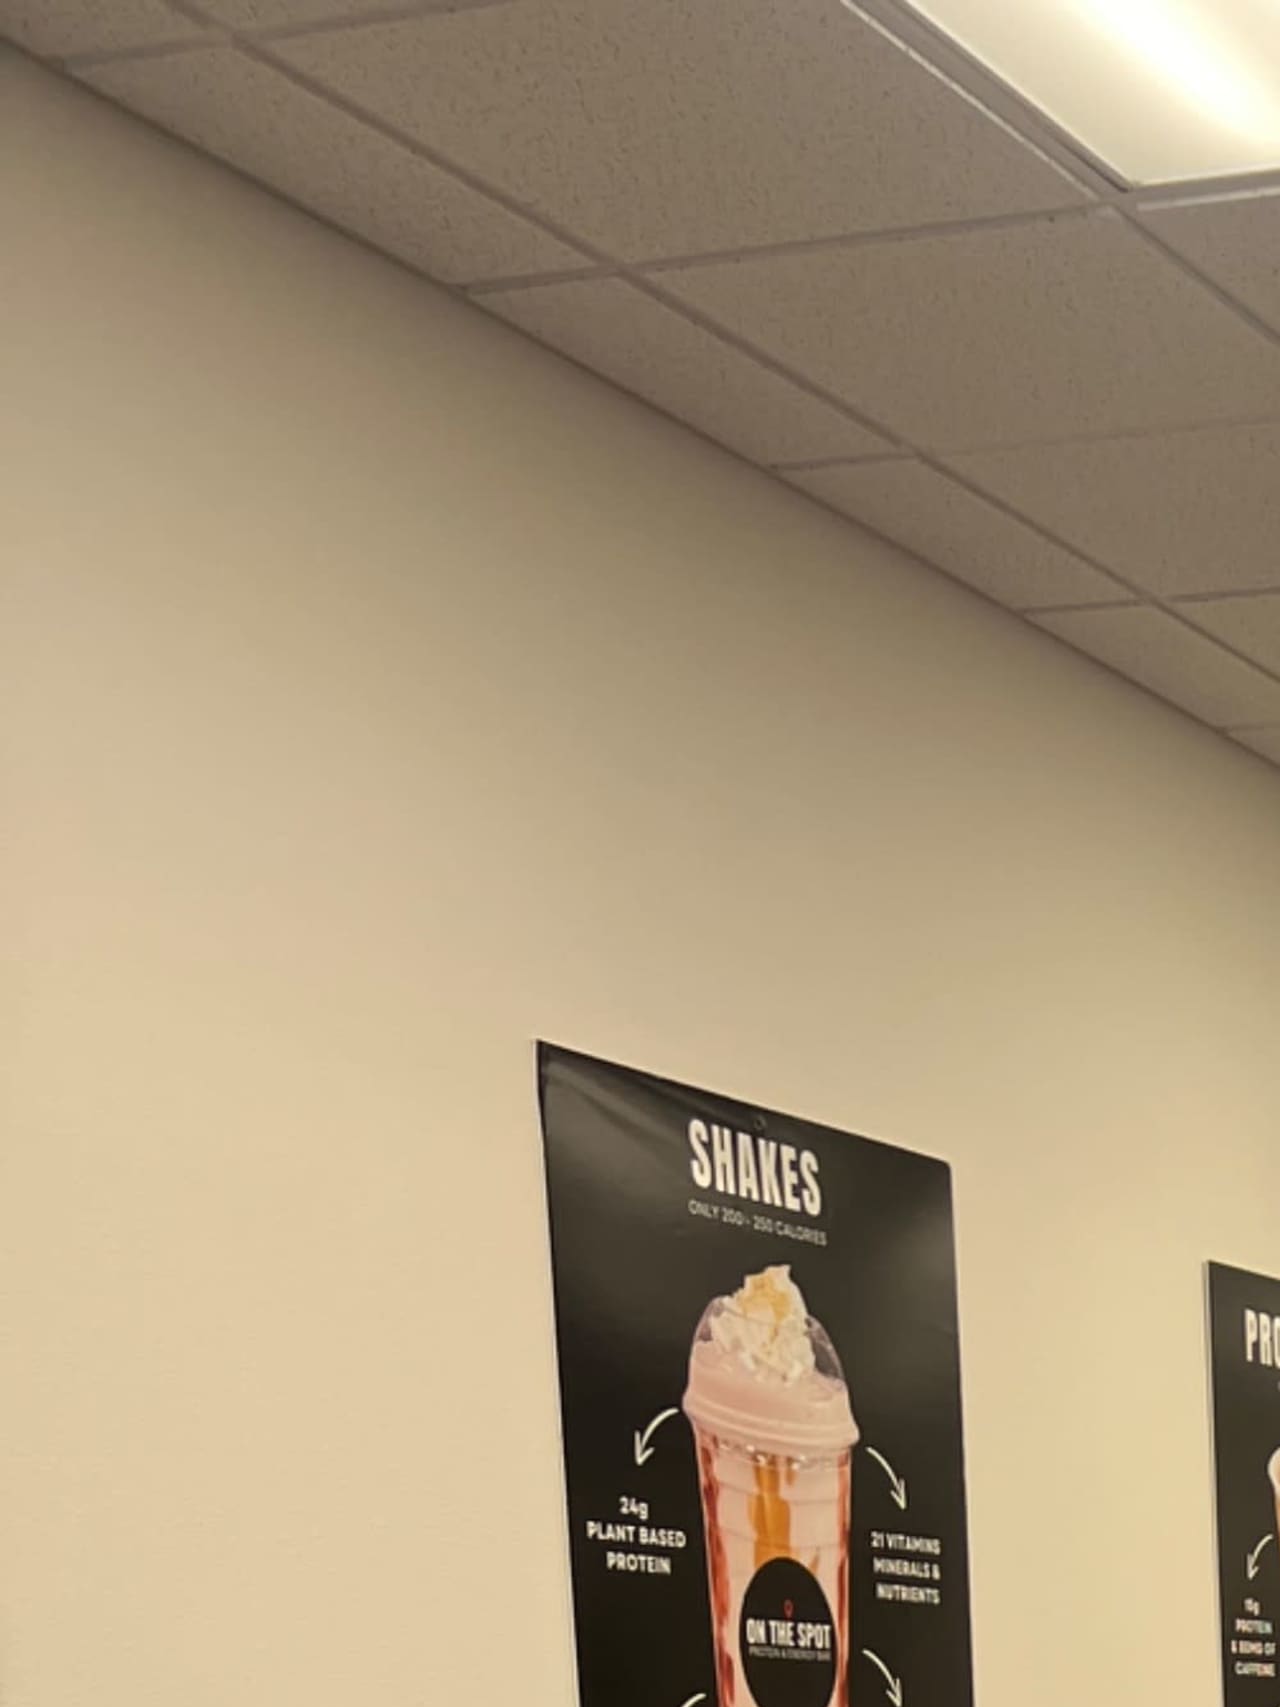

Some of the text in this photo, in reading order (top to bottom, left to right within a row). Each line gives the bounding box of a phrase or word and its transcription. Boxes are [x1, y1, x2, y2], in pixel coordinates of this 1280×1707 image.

[689, 1118, 821, 1216] SHAKES
[775, 1221, 827, 1246] CALORIES
[619, 1496, 649, 1521] 24g
[586, 1520, 687, 1548] PLANT BASED
[886, 1533, 940, 1555] VITAMINS
[606, 1551, 671, 1576] PROTEIN
[873, 1557, 930, 1579] MINERALS
[876, 1582, 940, 1605] NUTRIENTS
[746, 1618, 831, 1649] ON THE SPOT
[1235, 1619, 1273, 1635] PROTEIN
